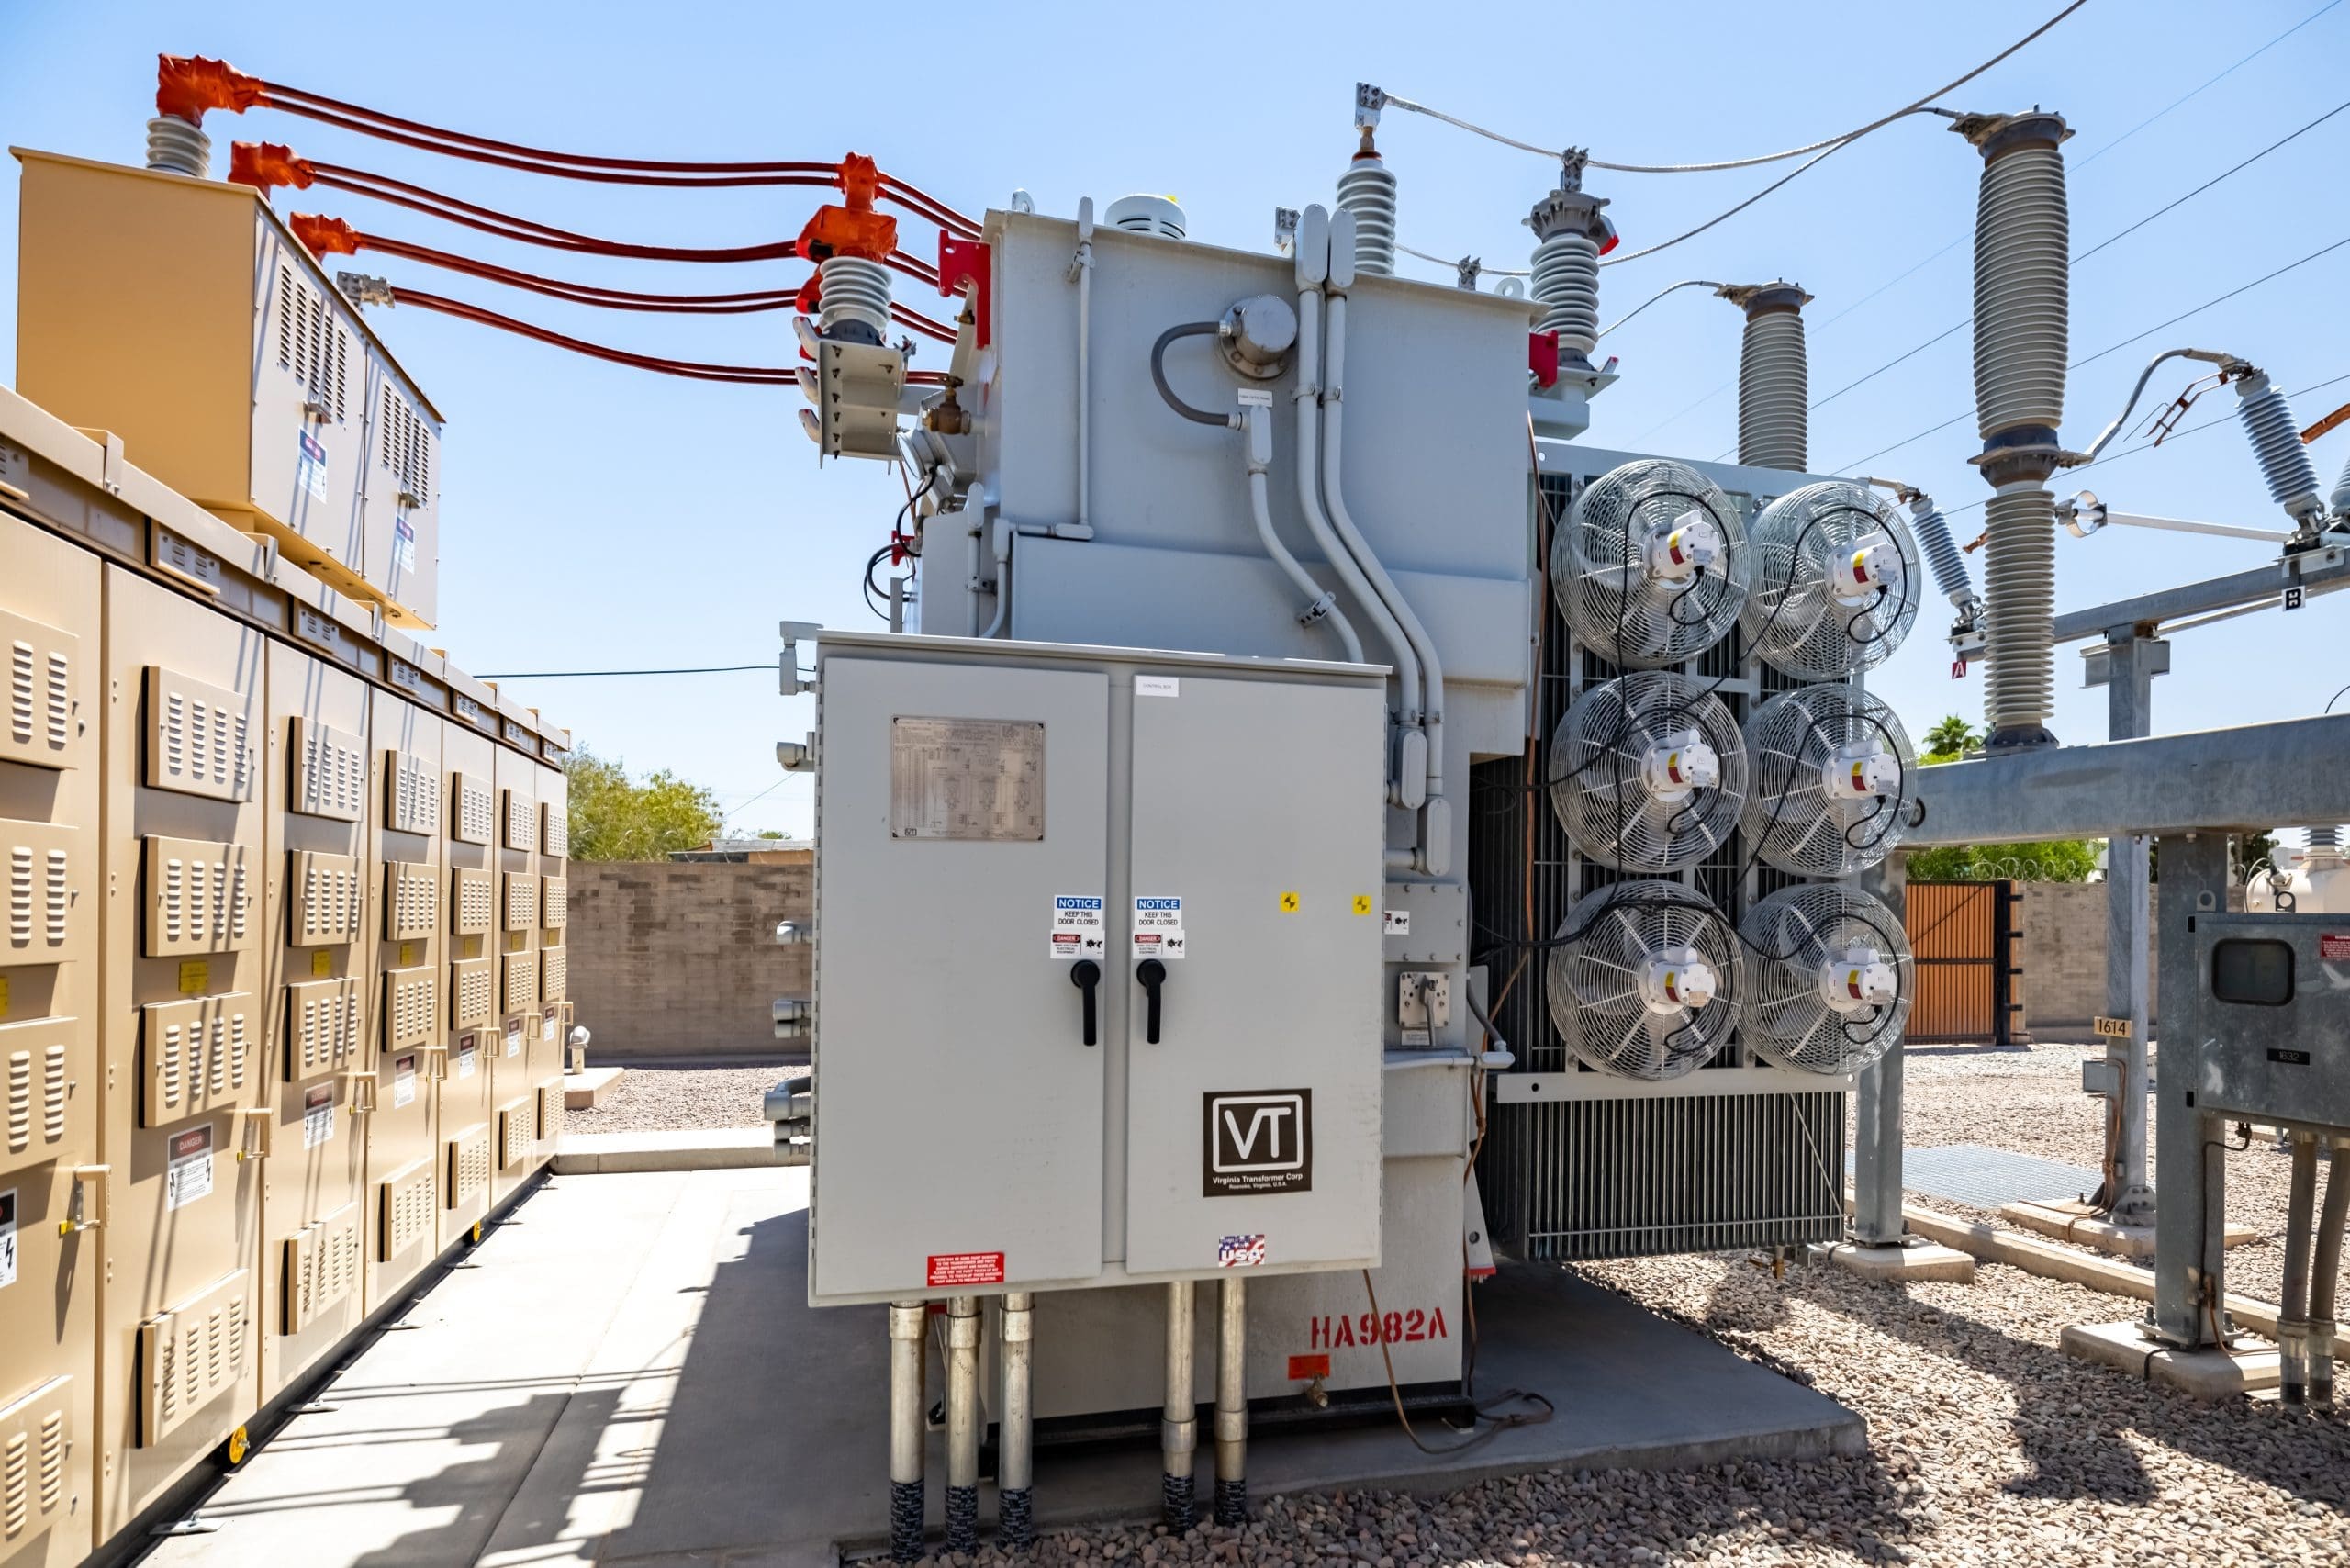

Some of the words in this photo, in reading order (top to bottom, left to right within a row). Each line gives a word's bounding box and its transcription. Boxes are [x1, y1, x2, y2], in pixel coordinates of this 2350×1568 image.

[2286, 588, 2301, 610] B
[1953, 661, 1965, 678] A
[1058, 899, 1100, 909] NOTICE
[1138, 900, 1177, 909] NOTICE
[2098, 1019, 2126, 1036] 1614
[1224, 1107, 1292, 1159] VT
[179, 1136, 202, 1151] DANGER
[1213, 1176, 1240, 1185] Virginia
[1241, 1174, 1284, 1183] Transformer
[1221, 1249, 1261, 1262] USA
[1311, 1306, 1448, 1350] HA982A
